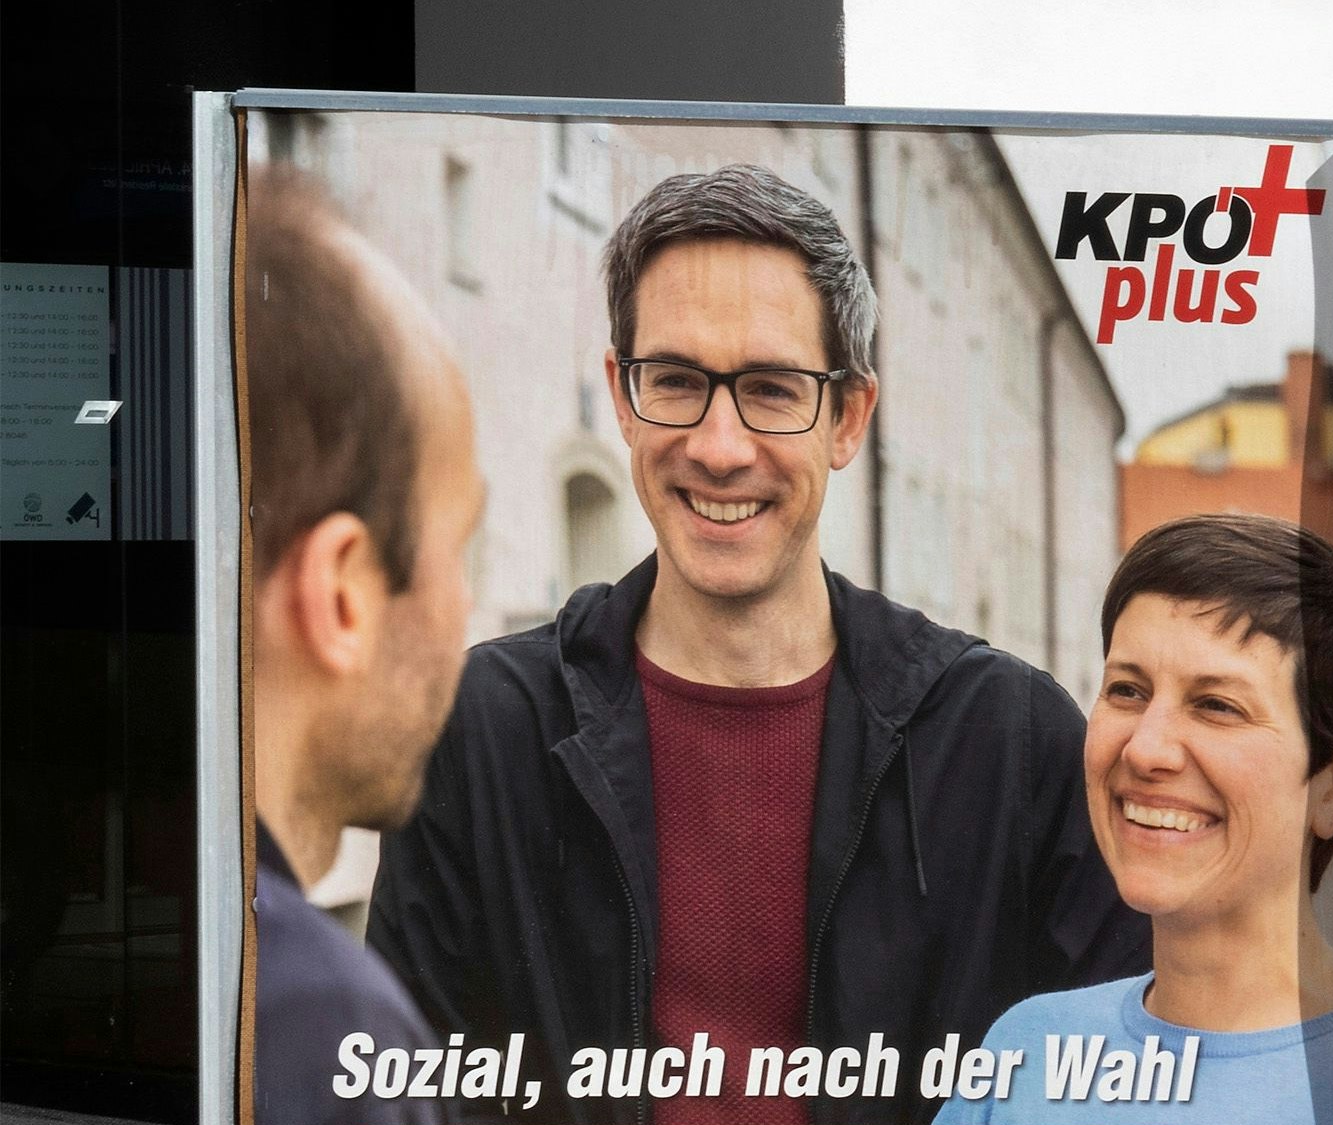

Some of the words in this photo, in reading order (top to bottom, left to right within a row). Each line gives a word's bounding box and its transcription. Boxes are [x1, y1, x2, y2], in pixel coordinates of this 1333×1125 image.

[1096, 243, 1260, 345] plus
[332, 1032, 543, 1110] Sozial,
[566, 1032, 726, 1099] auch
[745, 1032, 900, 1099] nach
[920, 1033, 1024, 1100] der
[1044, 1034, 1200, 1102] Wahl
